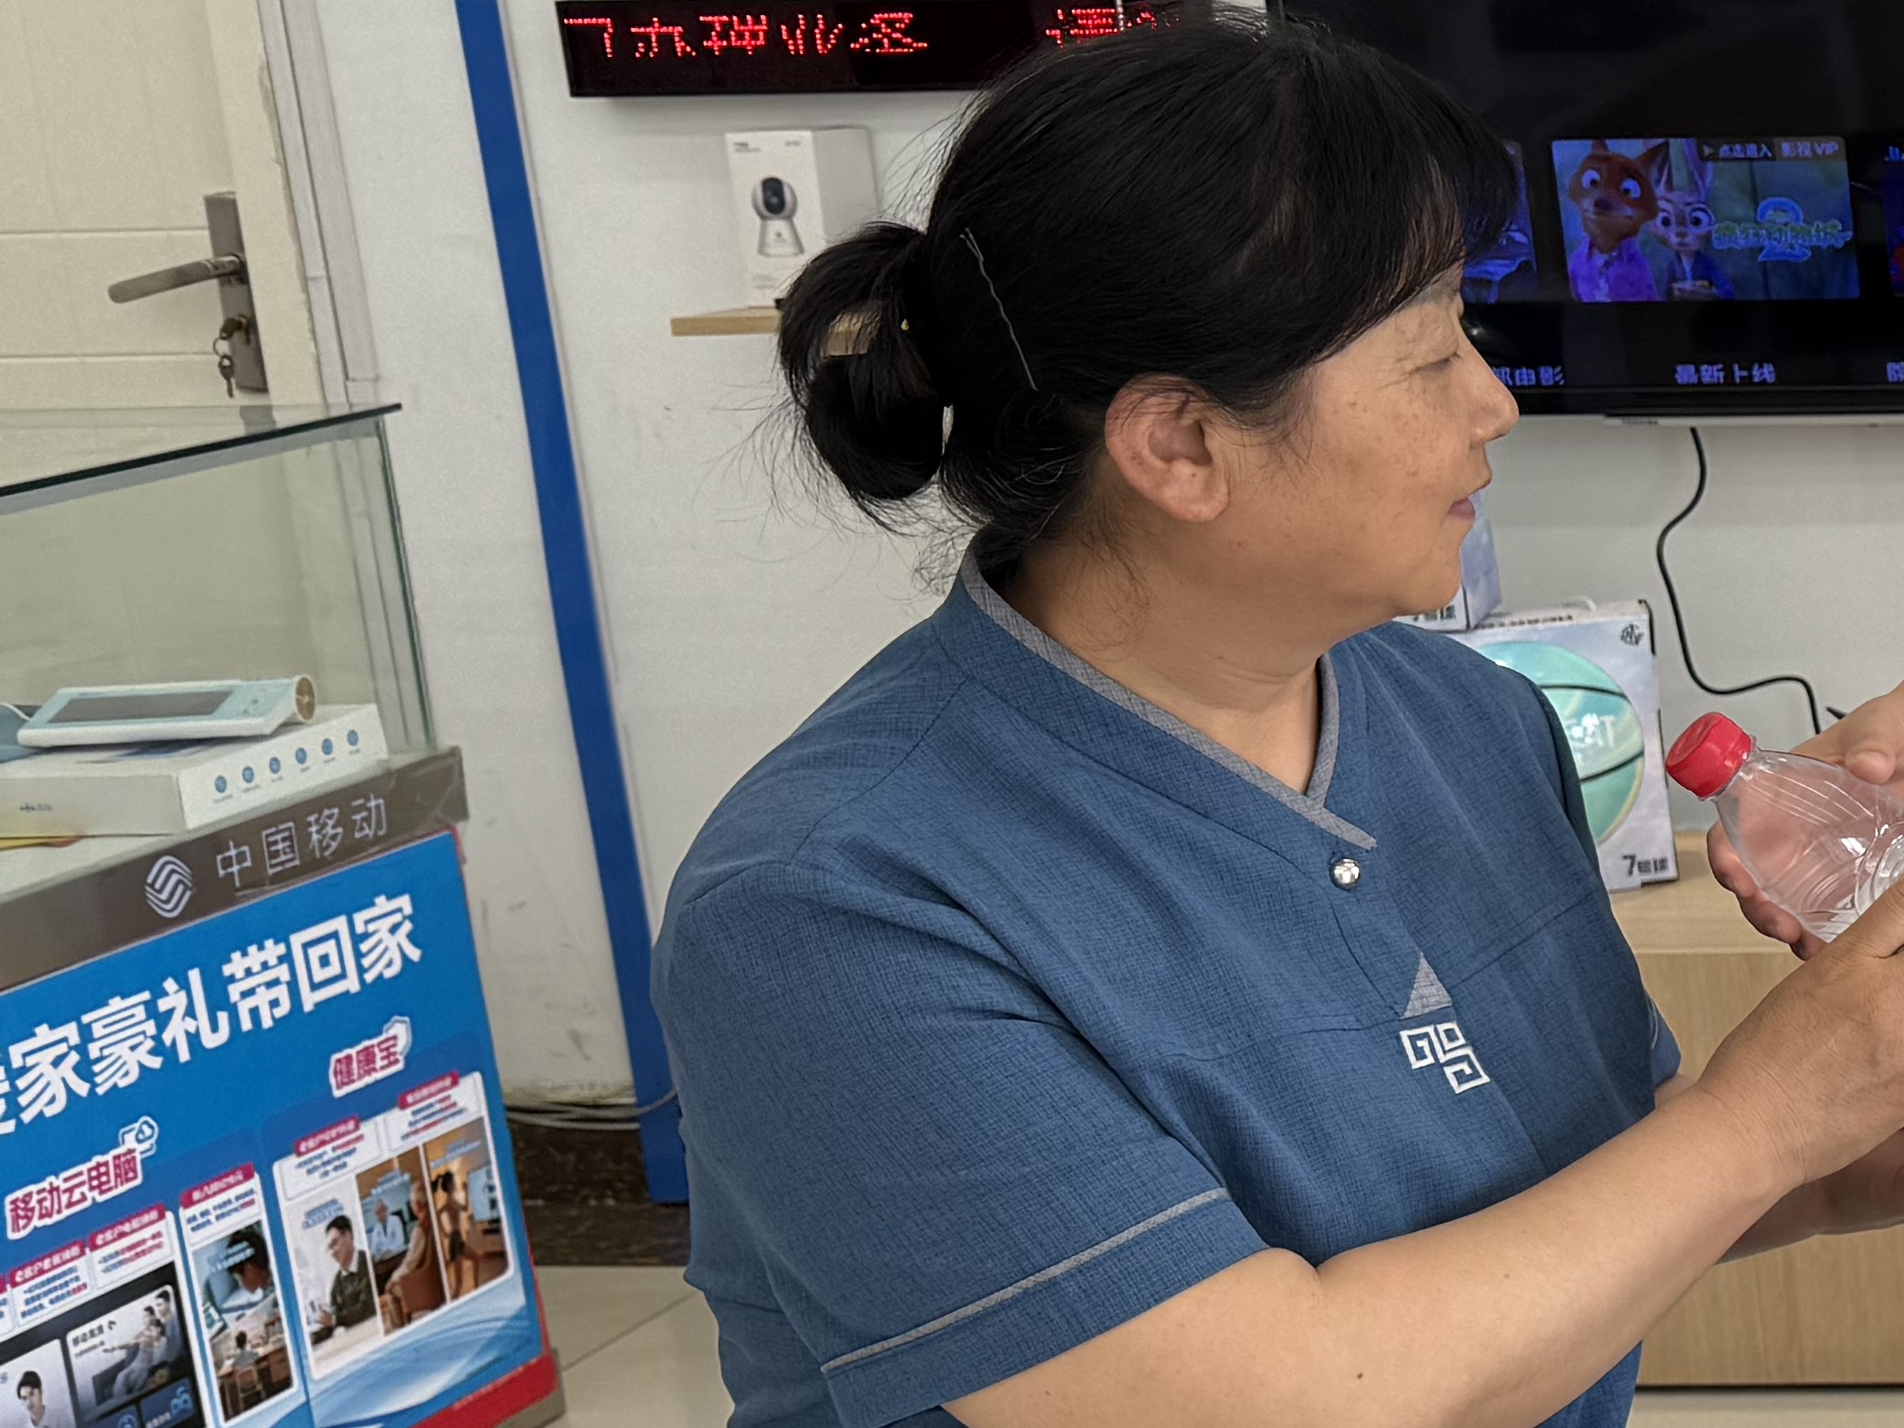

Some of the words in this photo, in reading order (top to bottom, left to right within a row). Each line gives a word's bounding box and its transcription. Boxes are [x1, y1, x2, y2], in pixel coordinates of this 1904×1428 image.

[215, 790, 389, 888] 中国移动
[0, 895, 422, 1134] 家豪礼带回家
[9, 1149, 139, 1234] 移动云电脑
